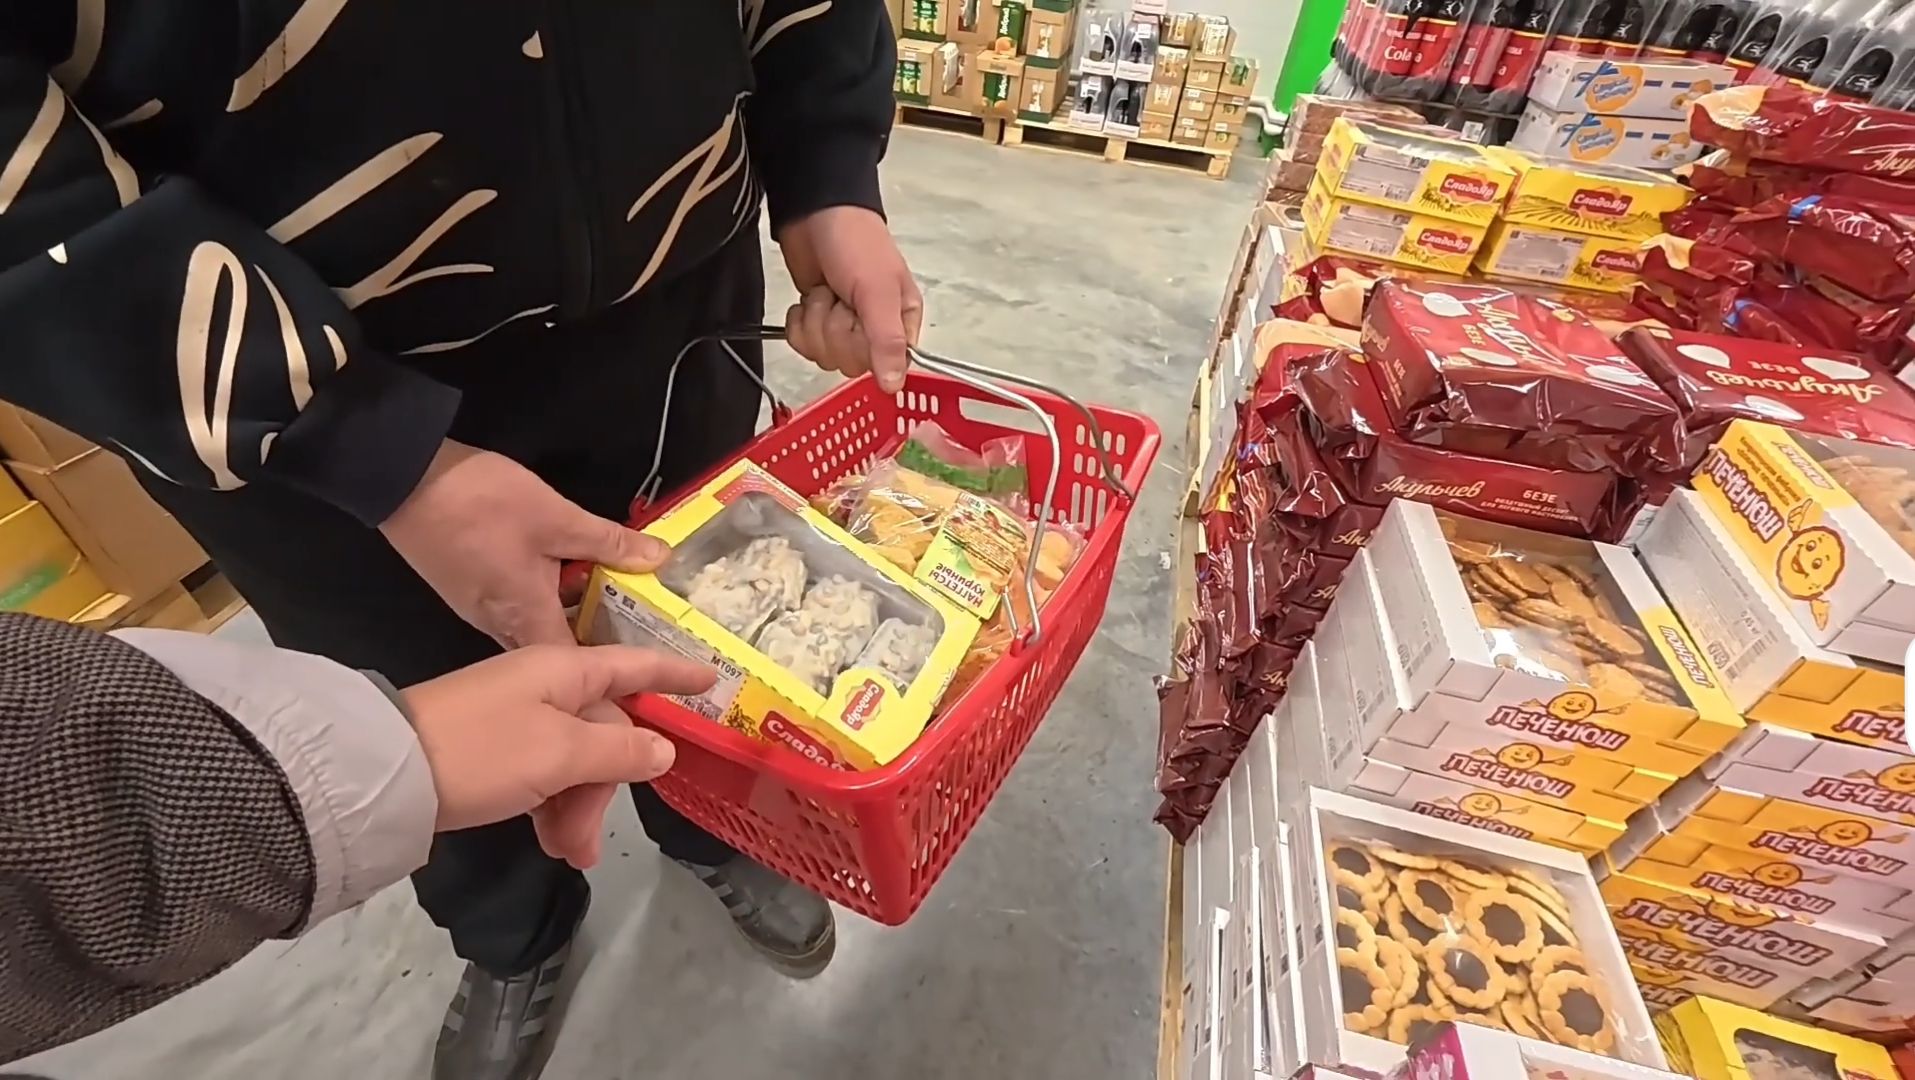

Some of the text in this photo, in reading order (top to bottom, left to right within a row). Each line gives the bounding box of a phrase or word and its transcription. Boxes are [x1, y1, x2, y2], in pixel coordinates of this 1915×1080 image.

[1707, 370, 1886, 403] Акульчев
[1373, 475, 1486, 499] Акульчев
[1522, 489, 1558, 504] БЕЗЕ
[1705, 450, 1784, 543] ПЕЧЕНЮШ
[928, 569, 983, 607] НАГГЕТСЫ
[1486, 706, 1631, 751] ПЕЧЕНЮШ
[1440, 753, 1576, 799] ПЕЧЕНЮШ
[1749, 830, 1908, 876] ПЕЧЕНЮШ
[1691, 872, 1837, 914] ПЕЧЕНЮШ
[1613, 898, 1834, 967] ПЕЧЕНЮШ
